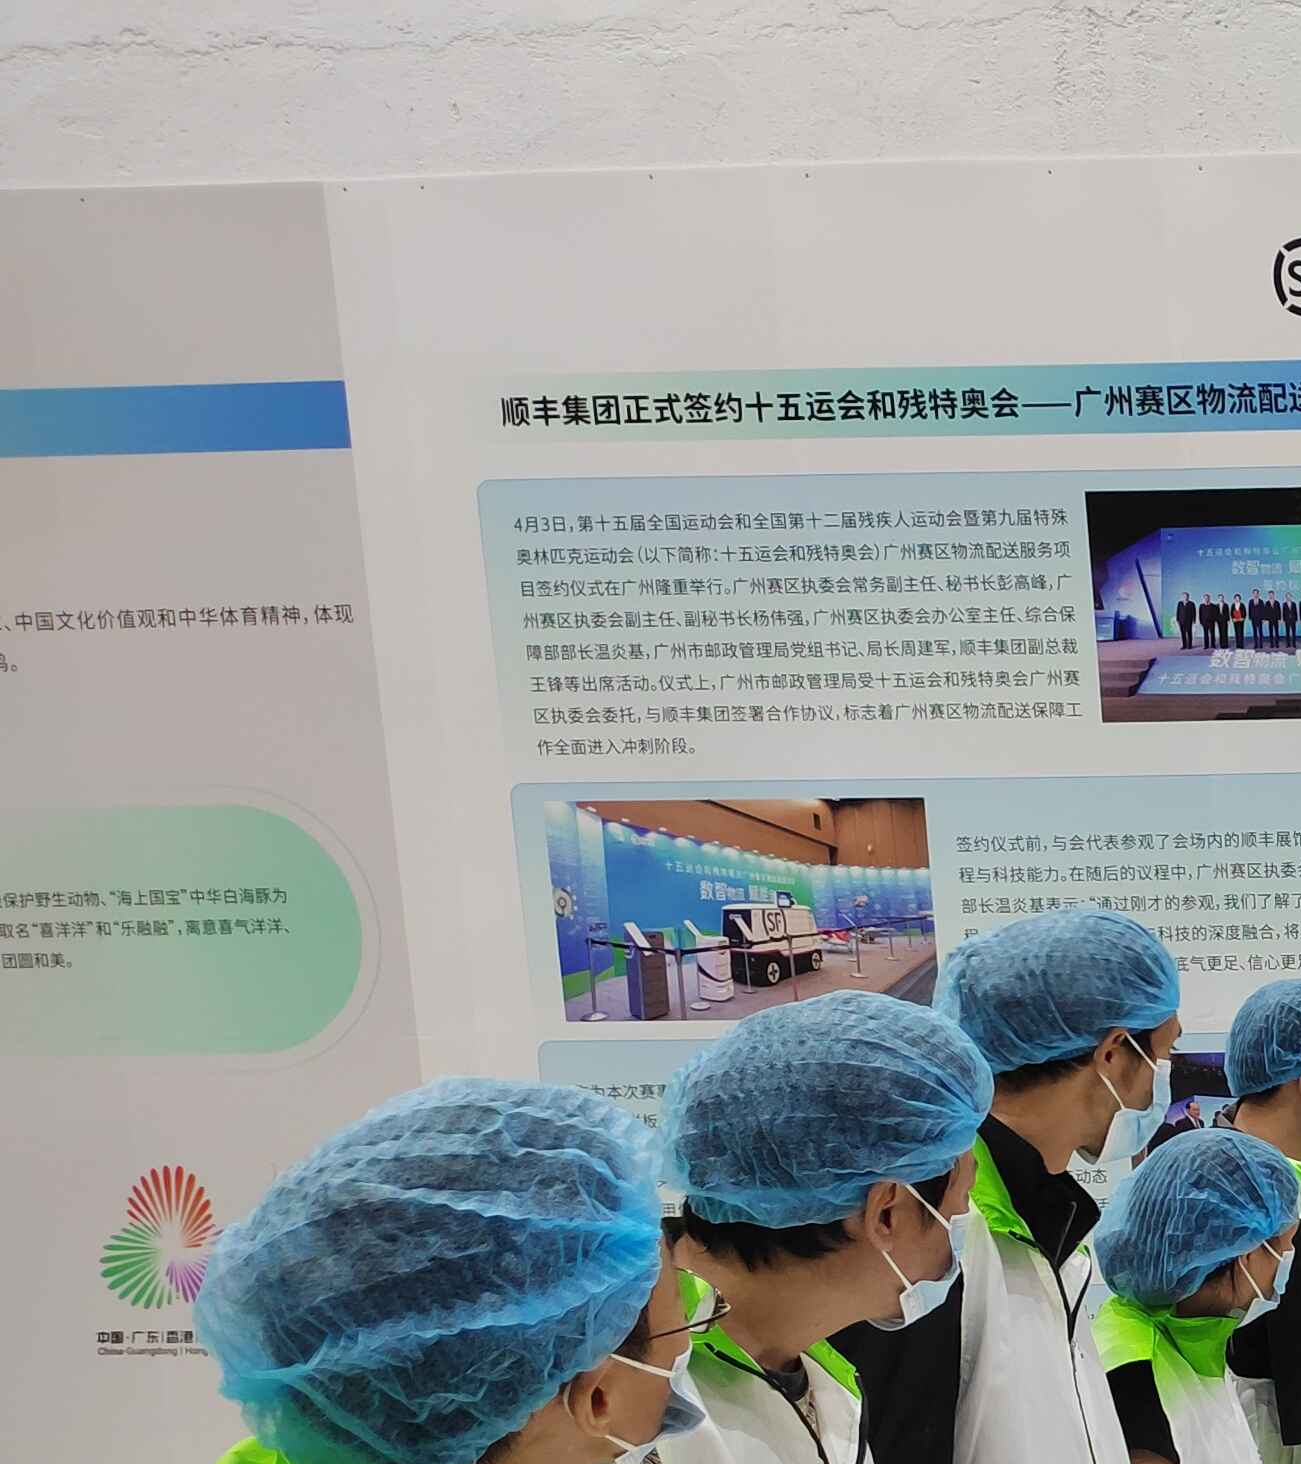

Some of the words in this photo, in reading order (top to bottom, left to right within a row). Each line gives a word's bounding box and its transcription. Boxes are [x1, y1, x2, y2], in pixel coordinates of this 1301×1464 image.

[0, 604, 354, 632] 、中国文化价值观和中华体育精神，体现
[0, 888, 287, 908] 保护野生动物、“海上国宝”中华白海豚为
